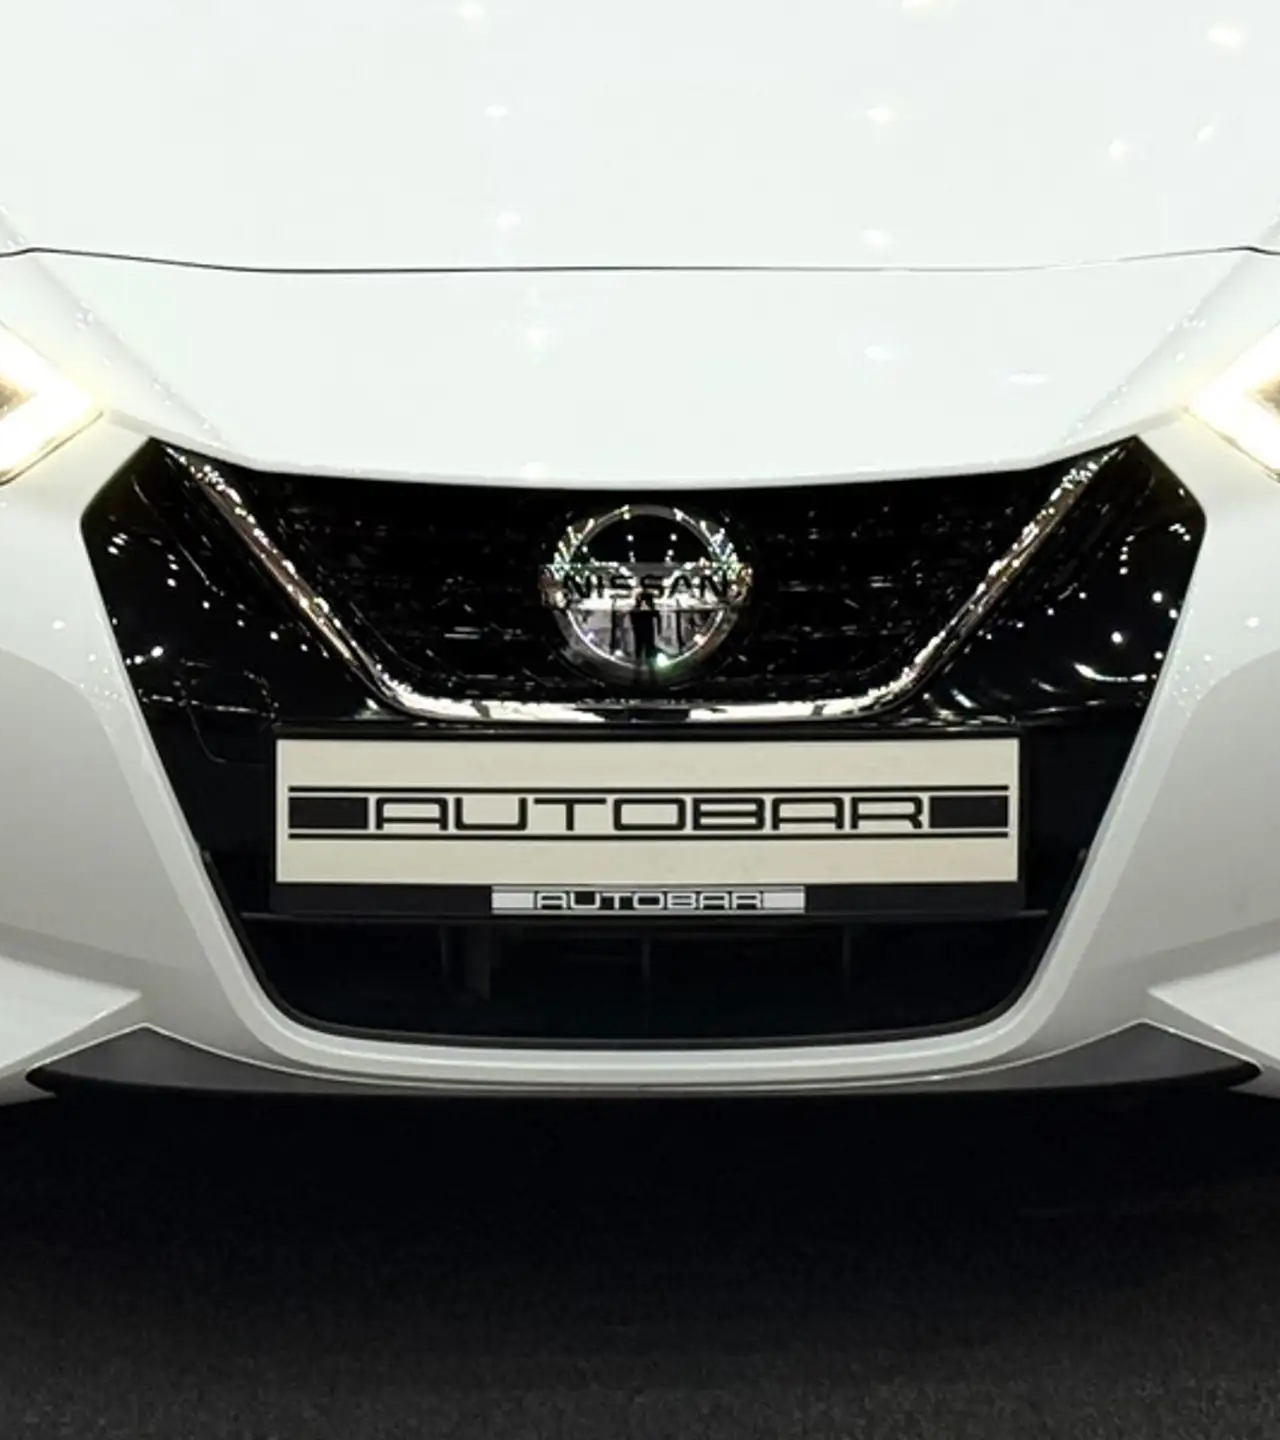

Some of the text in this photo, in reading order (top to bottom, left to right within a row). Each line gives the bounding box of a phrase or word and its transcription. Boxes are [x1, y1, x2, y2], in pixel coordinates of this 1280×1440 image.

[564, 573, 729, 600] NISSAN
[375, 796, 924, 831] AUTOBAR
[536, 891, 762, 910] AUTOBAR
